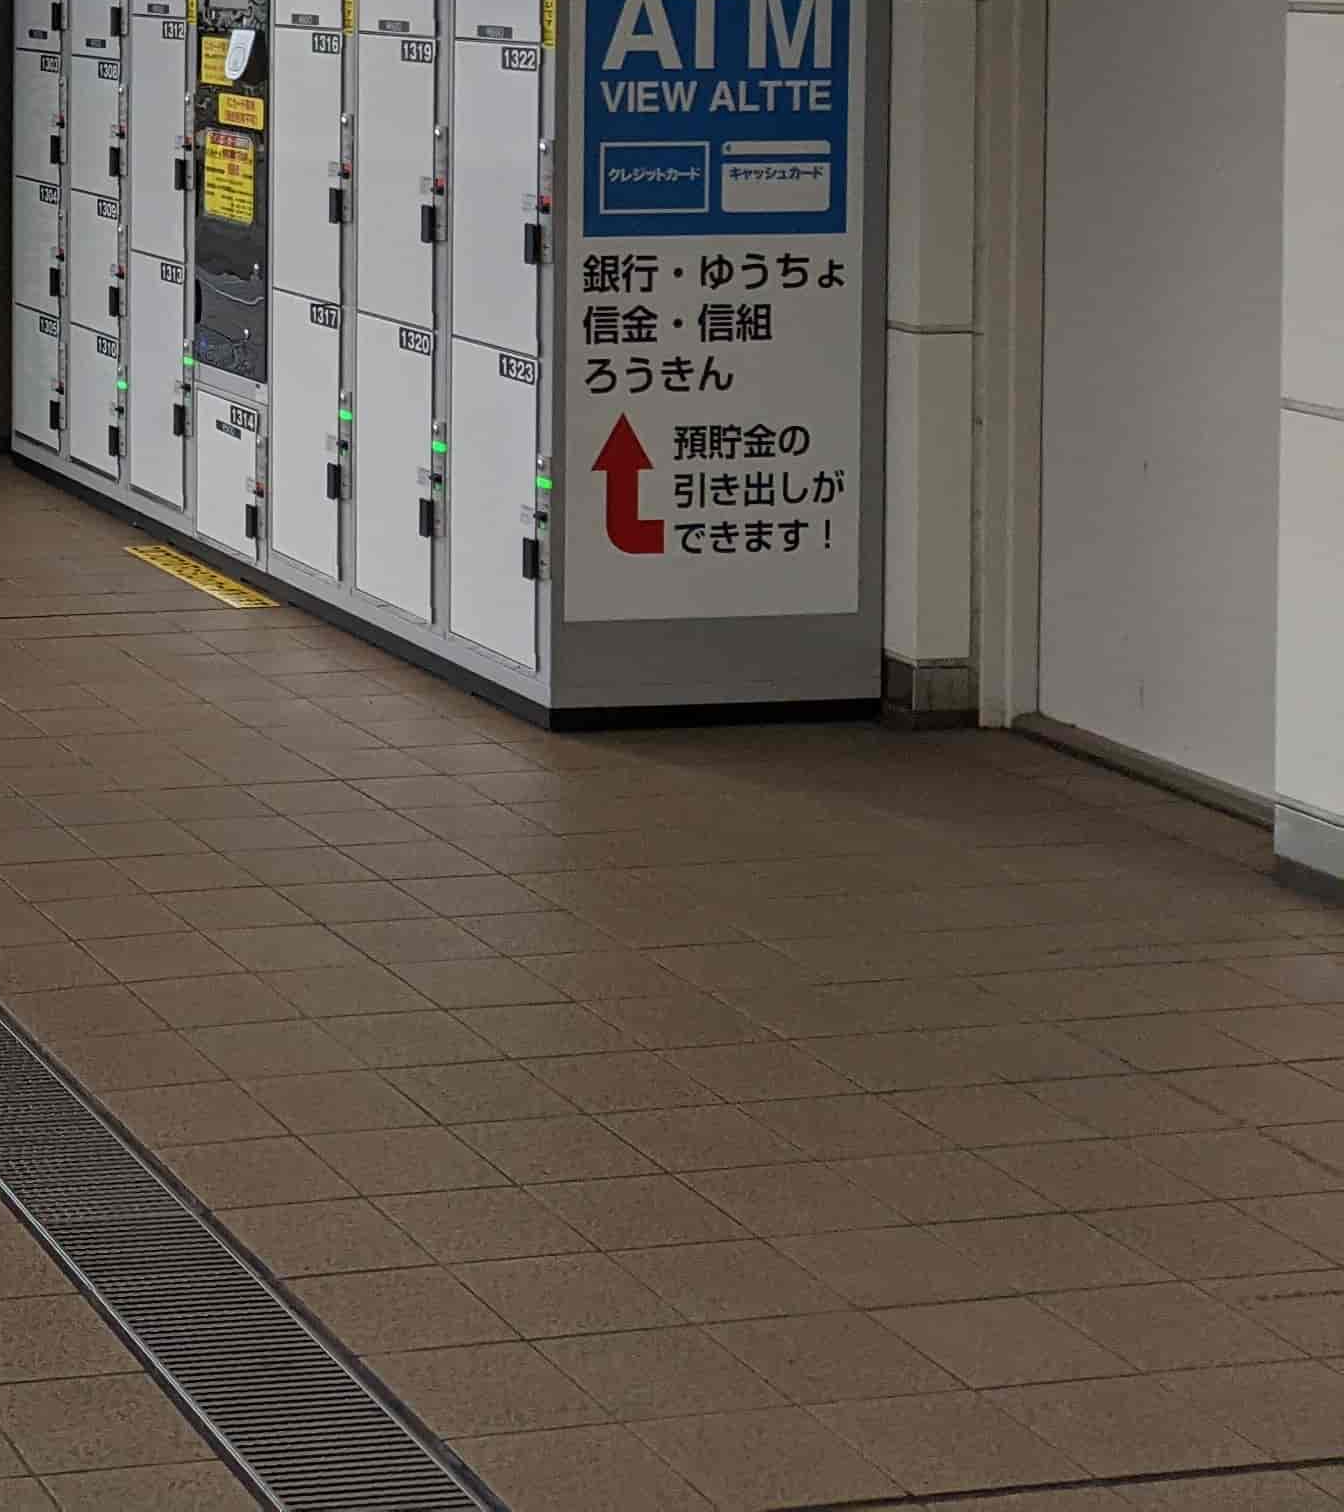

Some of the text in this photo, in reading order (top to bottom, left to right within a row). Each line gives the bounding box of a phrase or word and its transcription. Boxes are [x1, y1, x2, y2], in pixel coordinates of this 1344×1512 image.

[164, 22, 185, 38] 1312
[313, 35, 339, 52] 1316
[402, 42, 433, 62] 1319
[503, 48, 536, 69] 1322
[99, 63, 118, 79] 1308
[599, 79, 833, 114] VIEW ALTTE
[608, 167, 702, 183] クレジットカード
[728, 166, 824, 182] キャッシュカード
[41, 186, 58, 203] 1304
[162, 264, 183, 283] 1313
[582, 252, 846, 294] 銀行・ゆうちょ
[40, 318, 58, 335] 1305
[312, 305, 337, 327] 1317
[582, 303, 773, 345] 信金・信組
[98, 337, 117, 357] 1310
[400, 328, 431, 353] 1320
[500, 355, 535, 383] 1323
[584, 356, 734, 394] ろうきん
[231, 407, 256, 430] 1314
[673, 424, 811, 461] 預貯金の
[673, 469, 845, 509] 引き出しが
[674, 519, 832, 555] できます！
